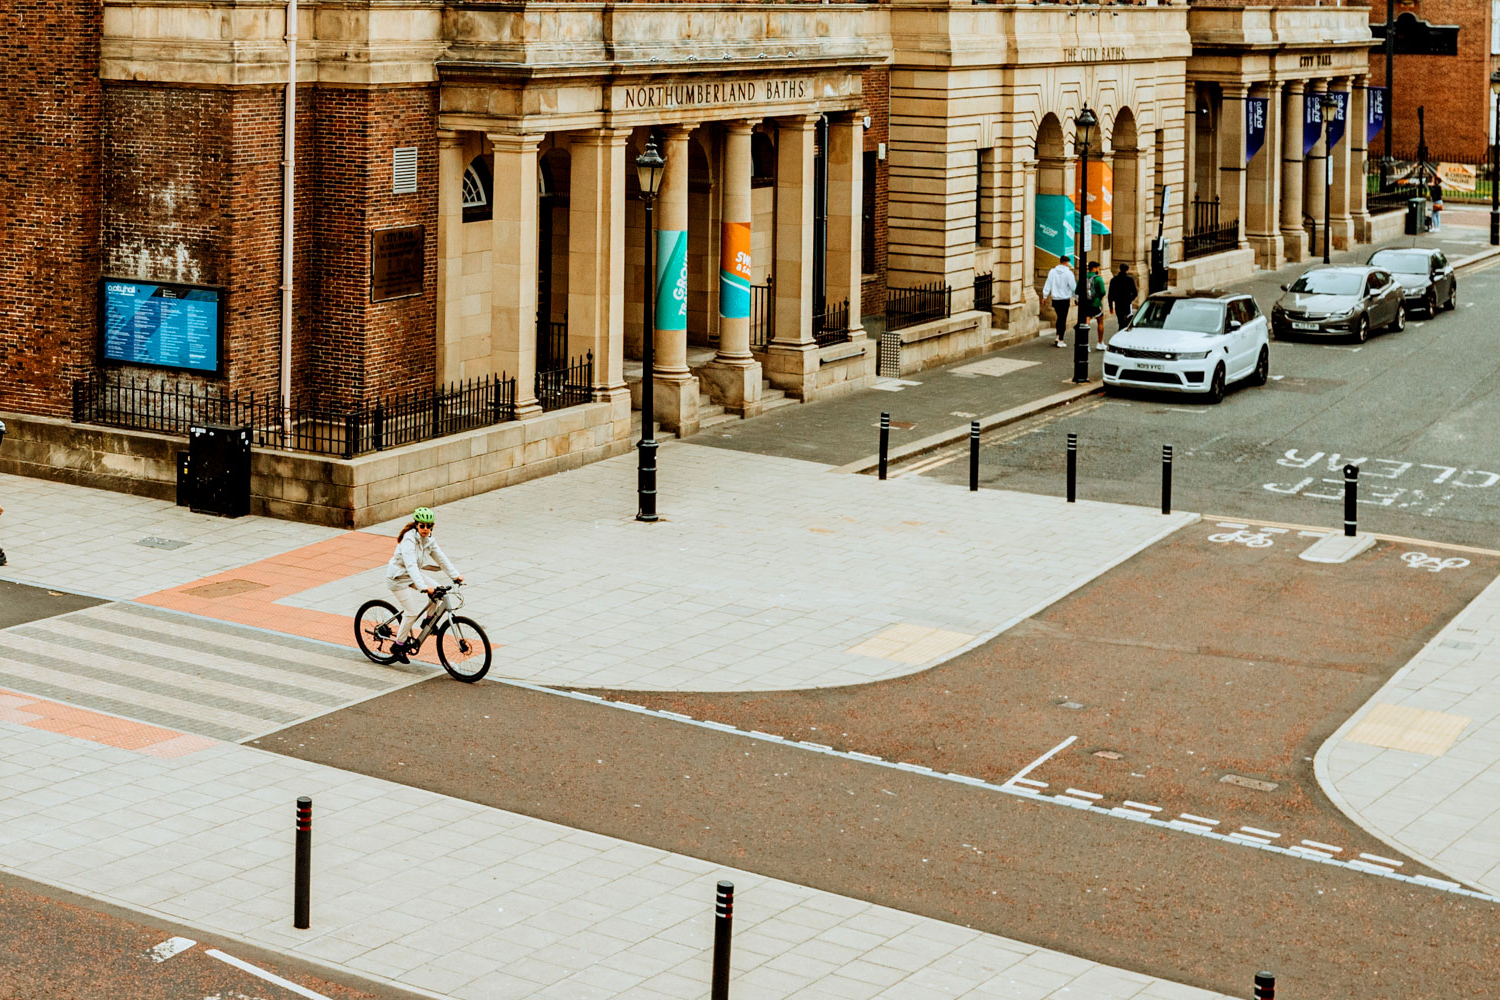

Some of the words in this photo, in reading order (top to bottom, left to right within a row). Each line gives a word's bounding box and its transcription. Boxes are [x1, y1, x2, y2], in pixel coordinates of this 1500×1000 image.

[1063, 48, 1077, 62] THE
[1081, 48, 1097, 62] CITY
[1300, 56, 1314, 67] CITY
[626, 82, 756, 108] NORTHUMBERLAND
[673, 250, 687, 300] GRO
[1276, 449, 1500, 488] CLEAR
